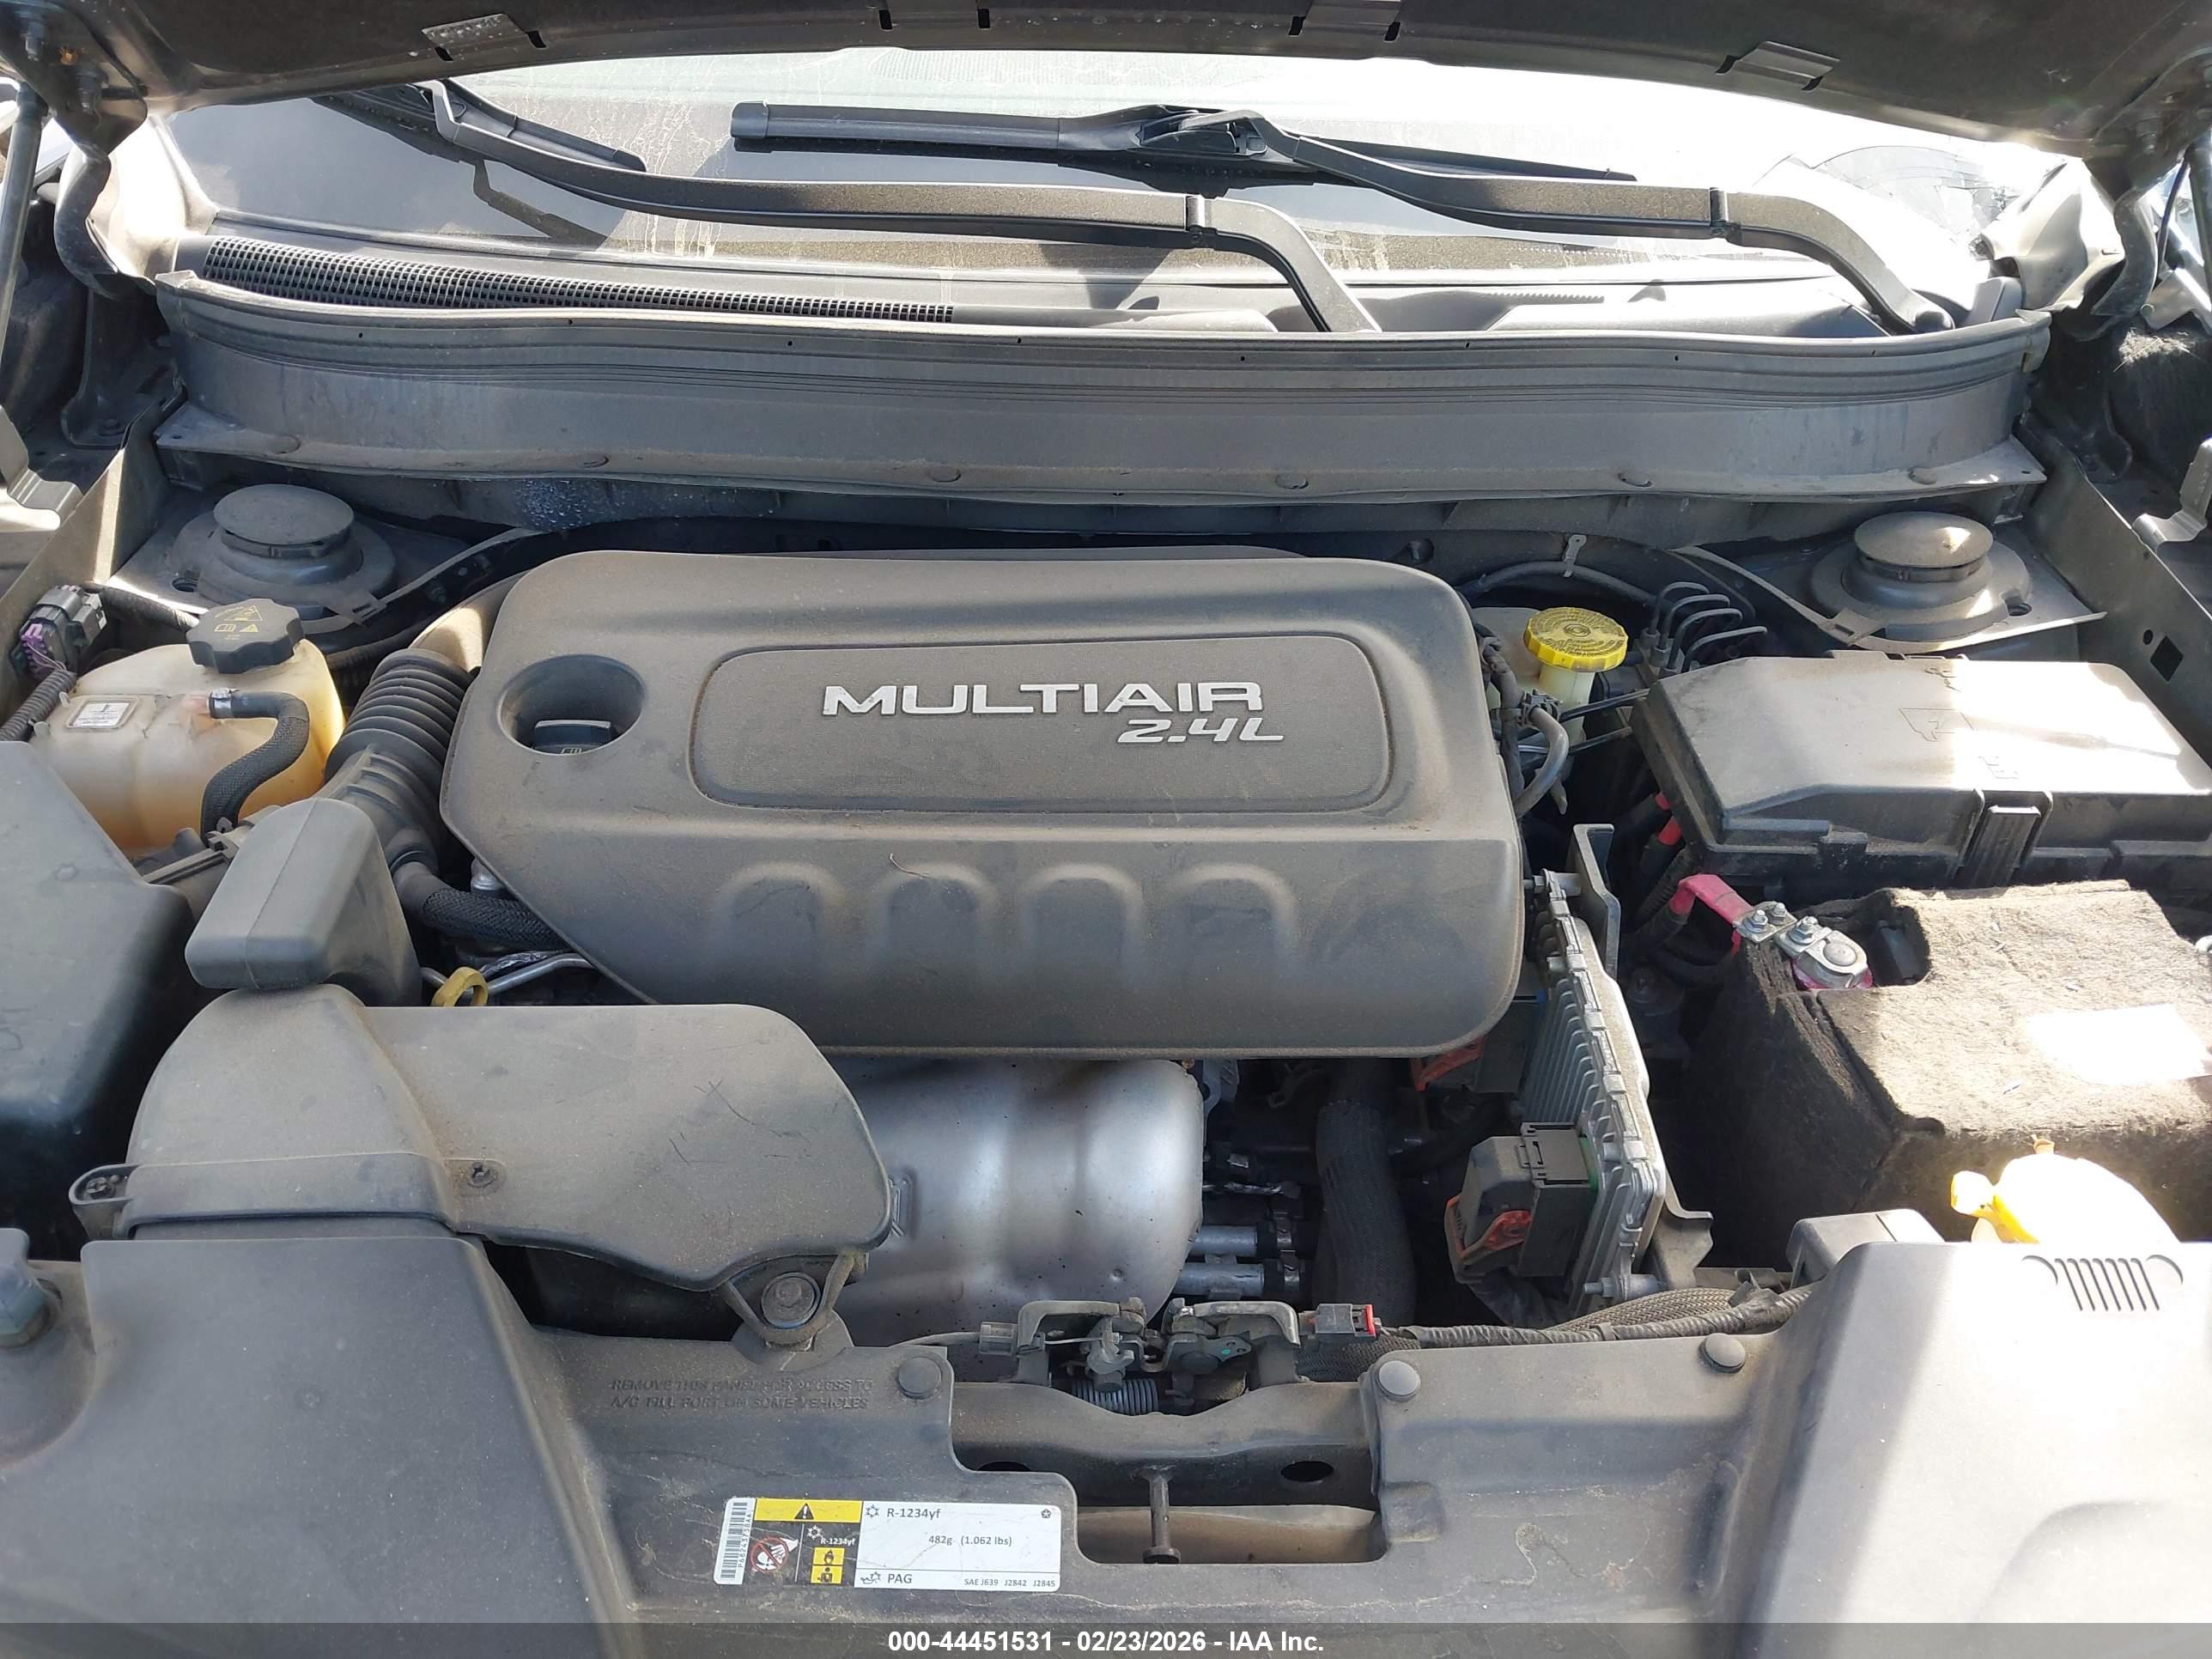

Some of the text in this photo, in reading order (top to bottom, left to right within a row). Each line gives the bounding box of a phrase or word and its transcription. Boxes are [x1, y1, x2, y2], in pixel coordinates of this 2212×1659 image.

[823, 682, 1264, 715] MULTIAIR
[1116, 717, 1284, 744] 2.4L
[887, 1508, 941, 1520] R-1234yf
[820, 1537, 855, 1546] R-1234yf
[928, 1535, 1012, 1546] 482g (1.062 lbs)
[887, 1574, 912, 1584] PAG
[981, 1578, 999, 1587] J639
[1004, 1579, 1027, 1588] J2842
[1032, 1579, 1055, 1588] J2845
